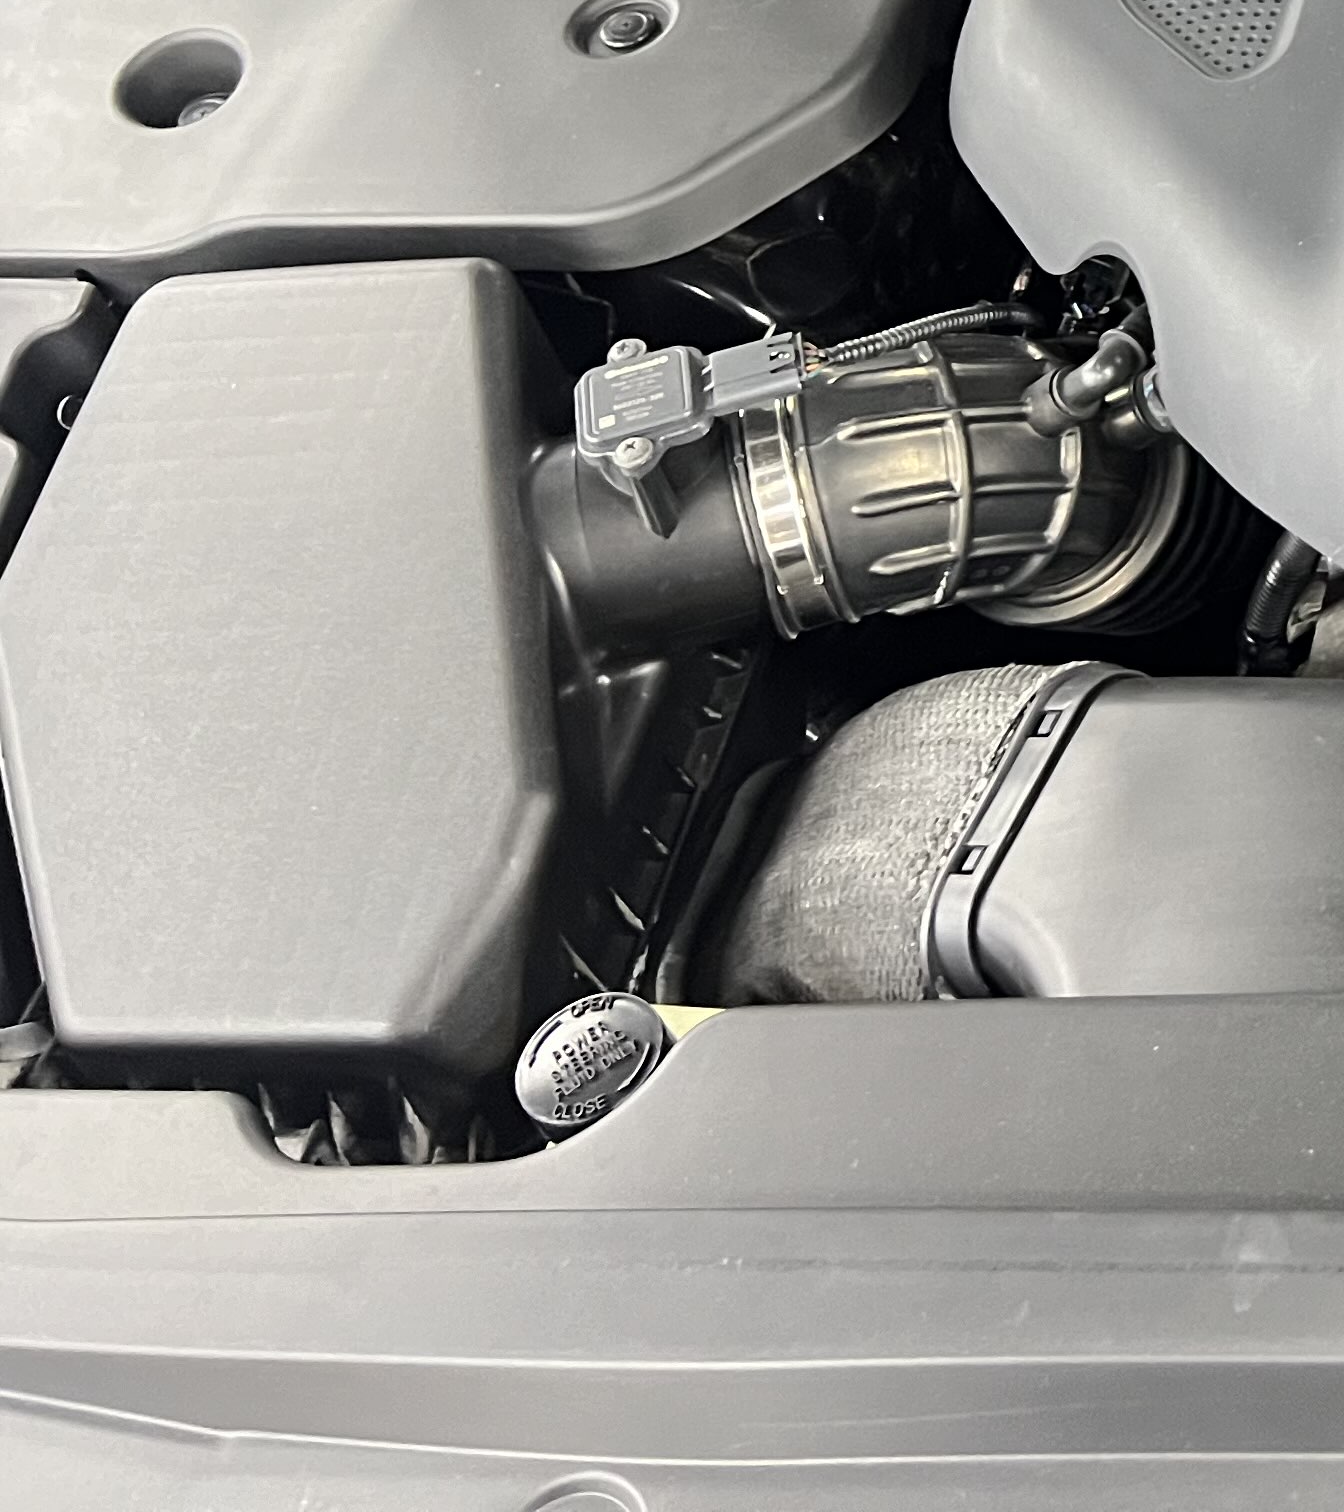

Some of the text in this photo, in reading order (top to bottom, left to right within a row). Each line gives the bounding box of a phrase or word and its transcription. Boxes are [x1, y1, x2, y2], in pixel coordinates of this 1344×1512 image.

[570, 995, 615, 1018] OPEN
[551, 1030, 626, 1084] STEERING
[552, 1021, 608, 1064] POWER
[553, 1039, 640, 1101] FLUID ONLY
[552, 1093, 608, 1120] CLOSE
